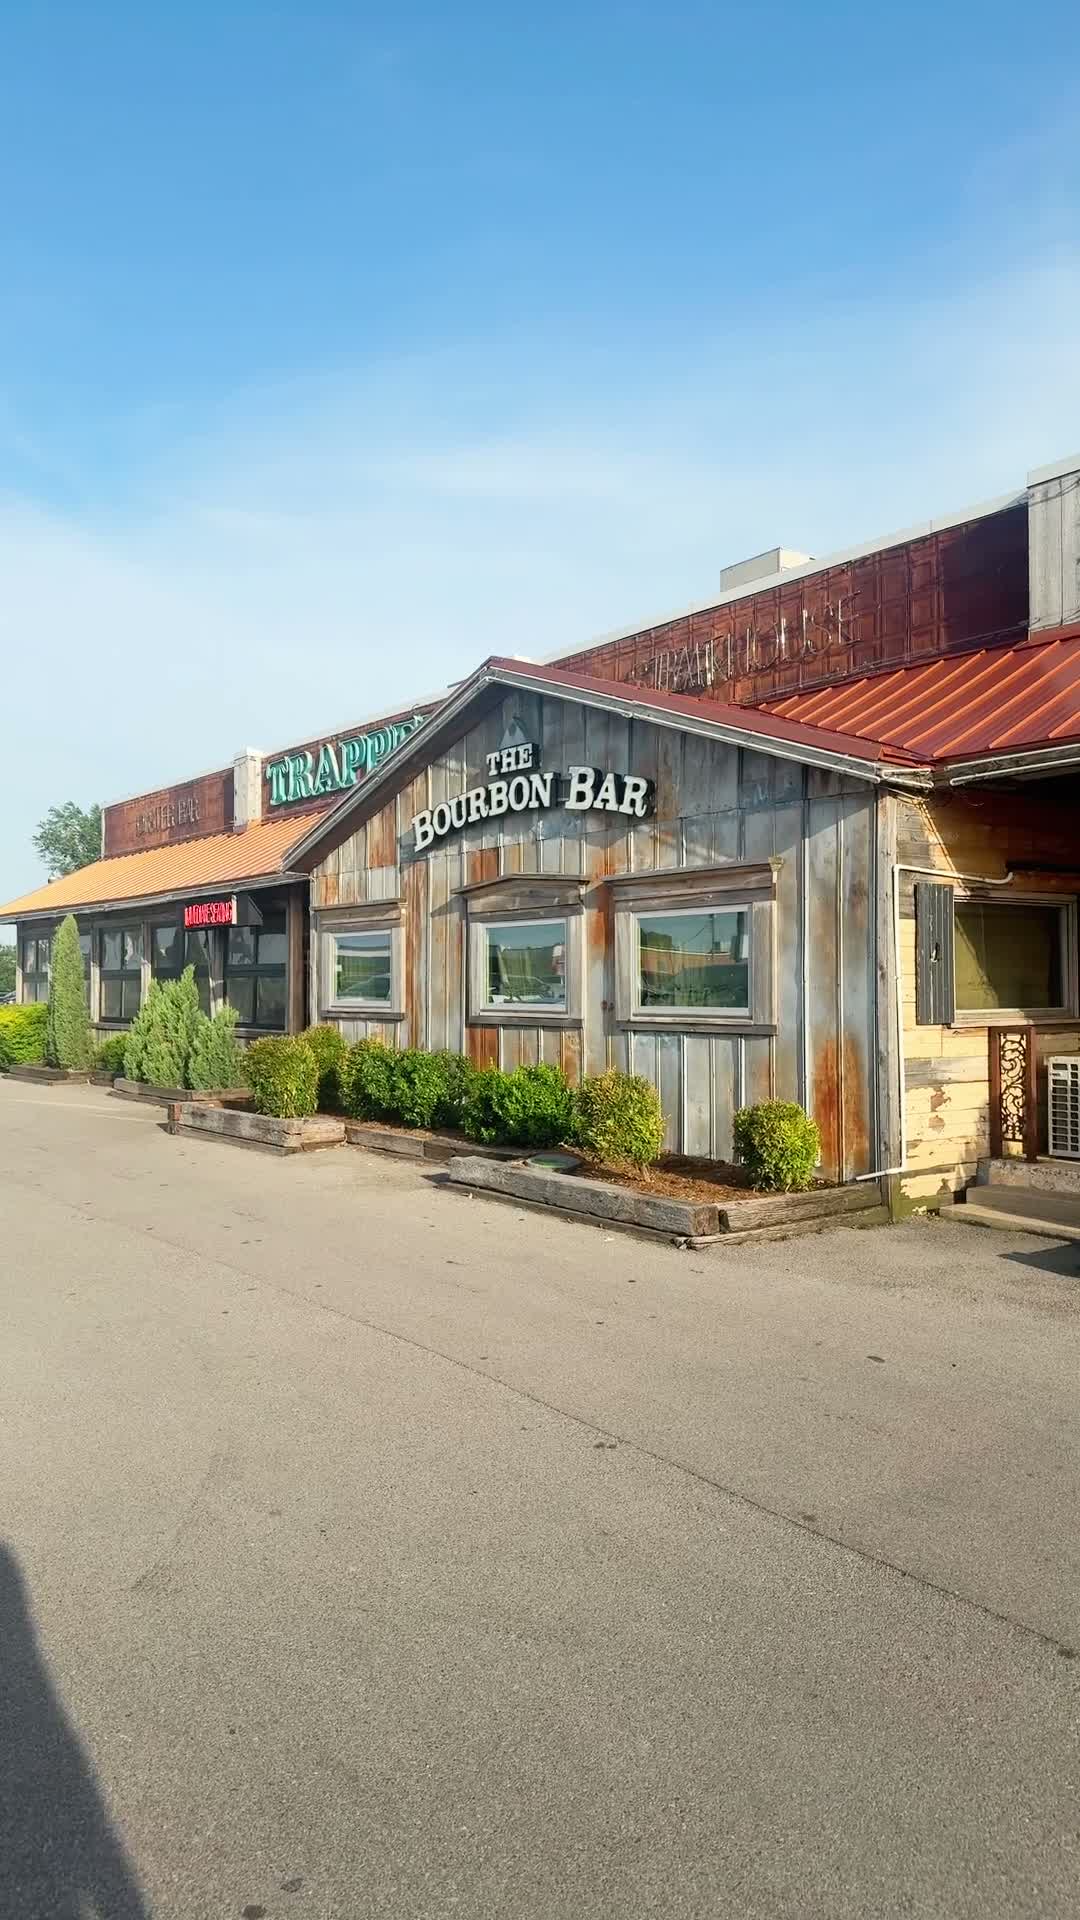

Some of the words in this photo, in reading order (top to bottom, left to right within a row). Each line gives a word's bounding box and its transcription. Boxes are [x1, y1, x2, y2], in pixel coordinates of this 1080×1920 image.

[486, 743, 533, 776] THE
[411, 772, 553, 852] BOURBON
[565, 765, 648, 818] BAR
